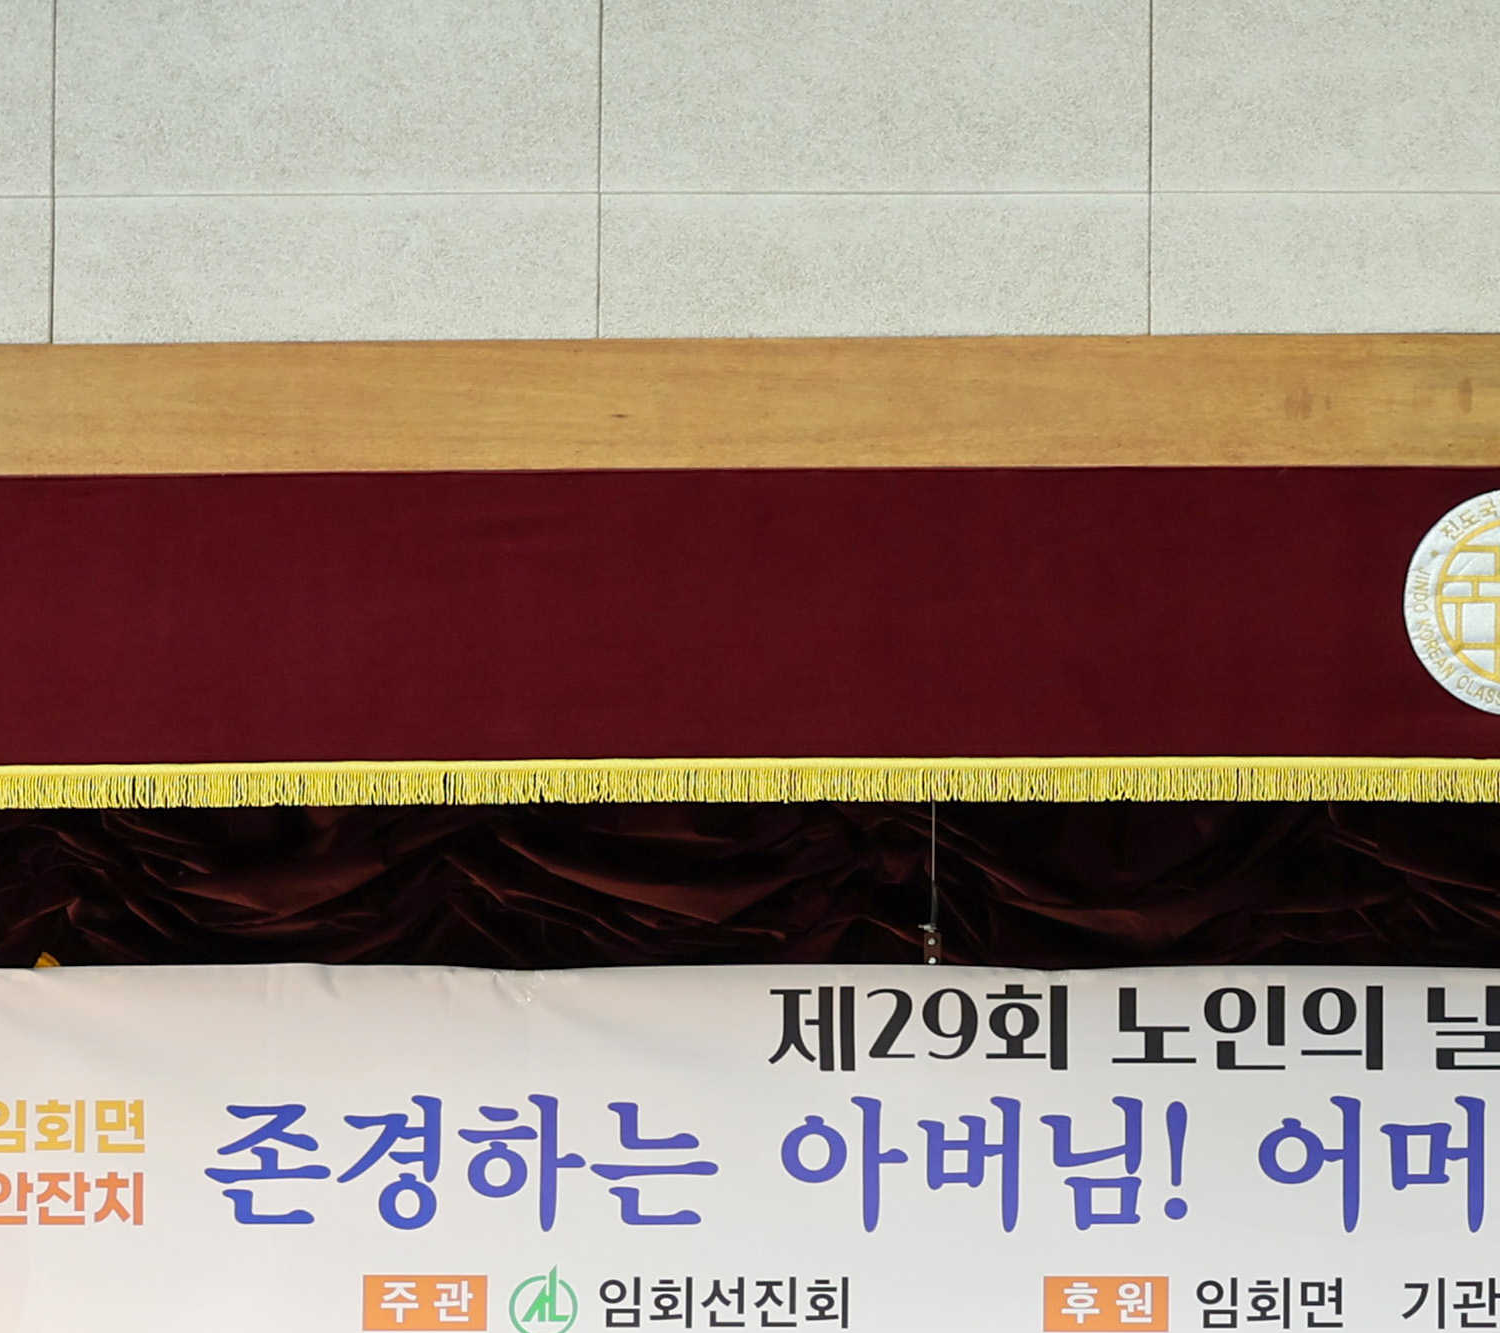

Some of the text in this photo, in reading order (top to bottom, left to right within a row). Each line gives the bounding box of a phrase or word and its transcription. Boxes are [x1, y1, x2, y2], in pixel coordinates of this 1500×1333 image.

[1413, 566, 1431, 613] JINDO
[1415, 619, 1457, 680] KOREAN
[769, 985, 1069, 1073] 제29회
[1112, 986, 1385, 1072] 노인의
[207, 1095, 718, 1233] 존경하는
[783, 1097, 1189, 1232] 아버님!
[380, 1277, 851, 1330] 주관 임회선진회
[1061, 1281, 1155, 1325] 후원
[1196, 1277, 1345, 1331] 임회면
